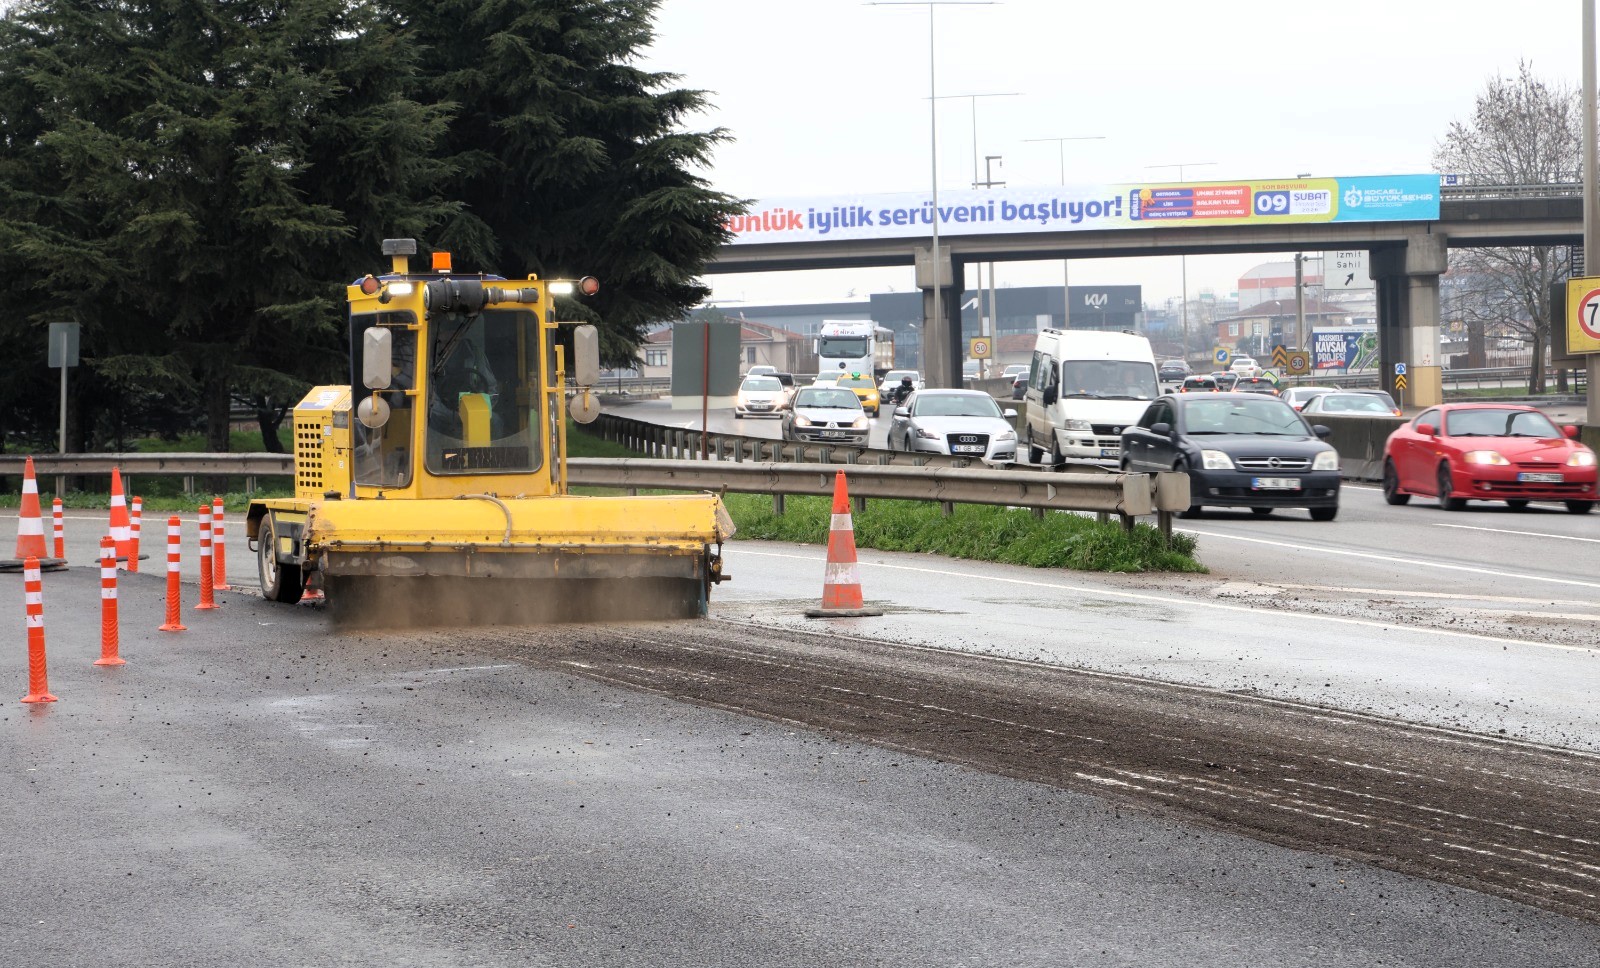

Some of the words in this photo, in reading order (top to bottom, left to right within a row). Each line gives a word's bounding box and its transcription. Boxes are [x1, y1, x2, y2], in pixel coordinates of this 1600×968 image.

[1257, 194, 1287, 212] 09
[808, 205, 873, 234] iyilik
[879, 200, 994, 226] serüveni
[1001, 195, 1122, 225] başlıyor!
[1336, 261, 1361, 269] Sahil
[976, 344, 986, 352] 50
[1292, 358, 1303, 368] 50
